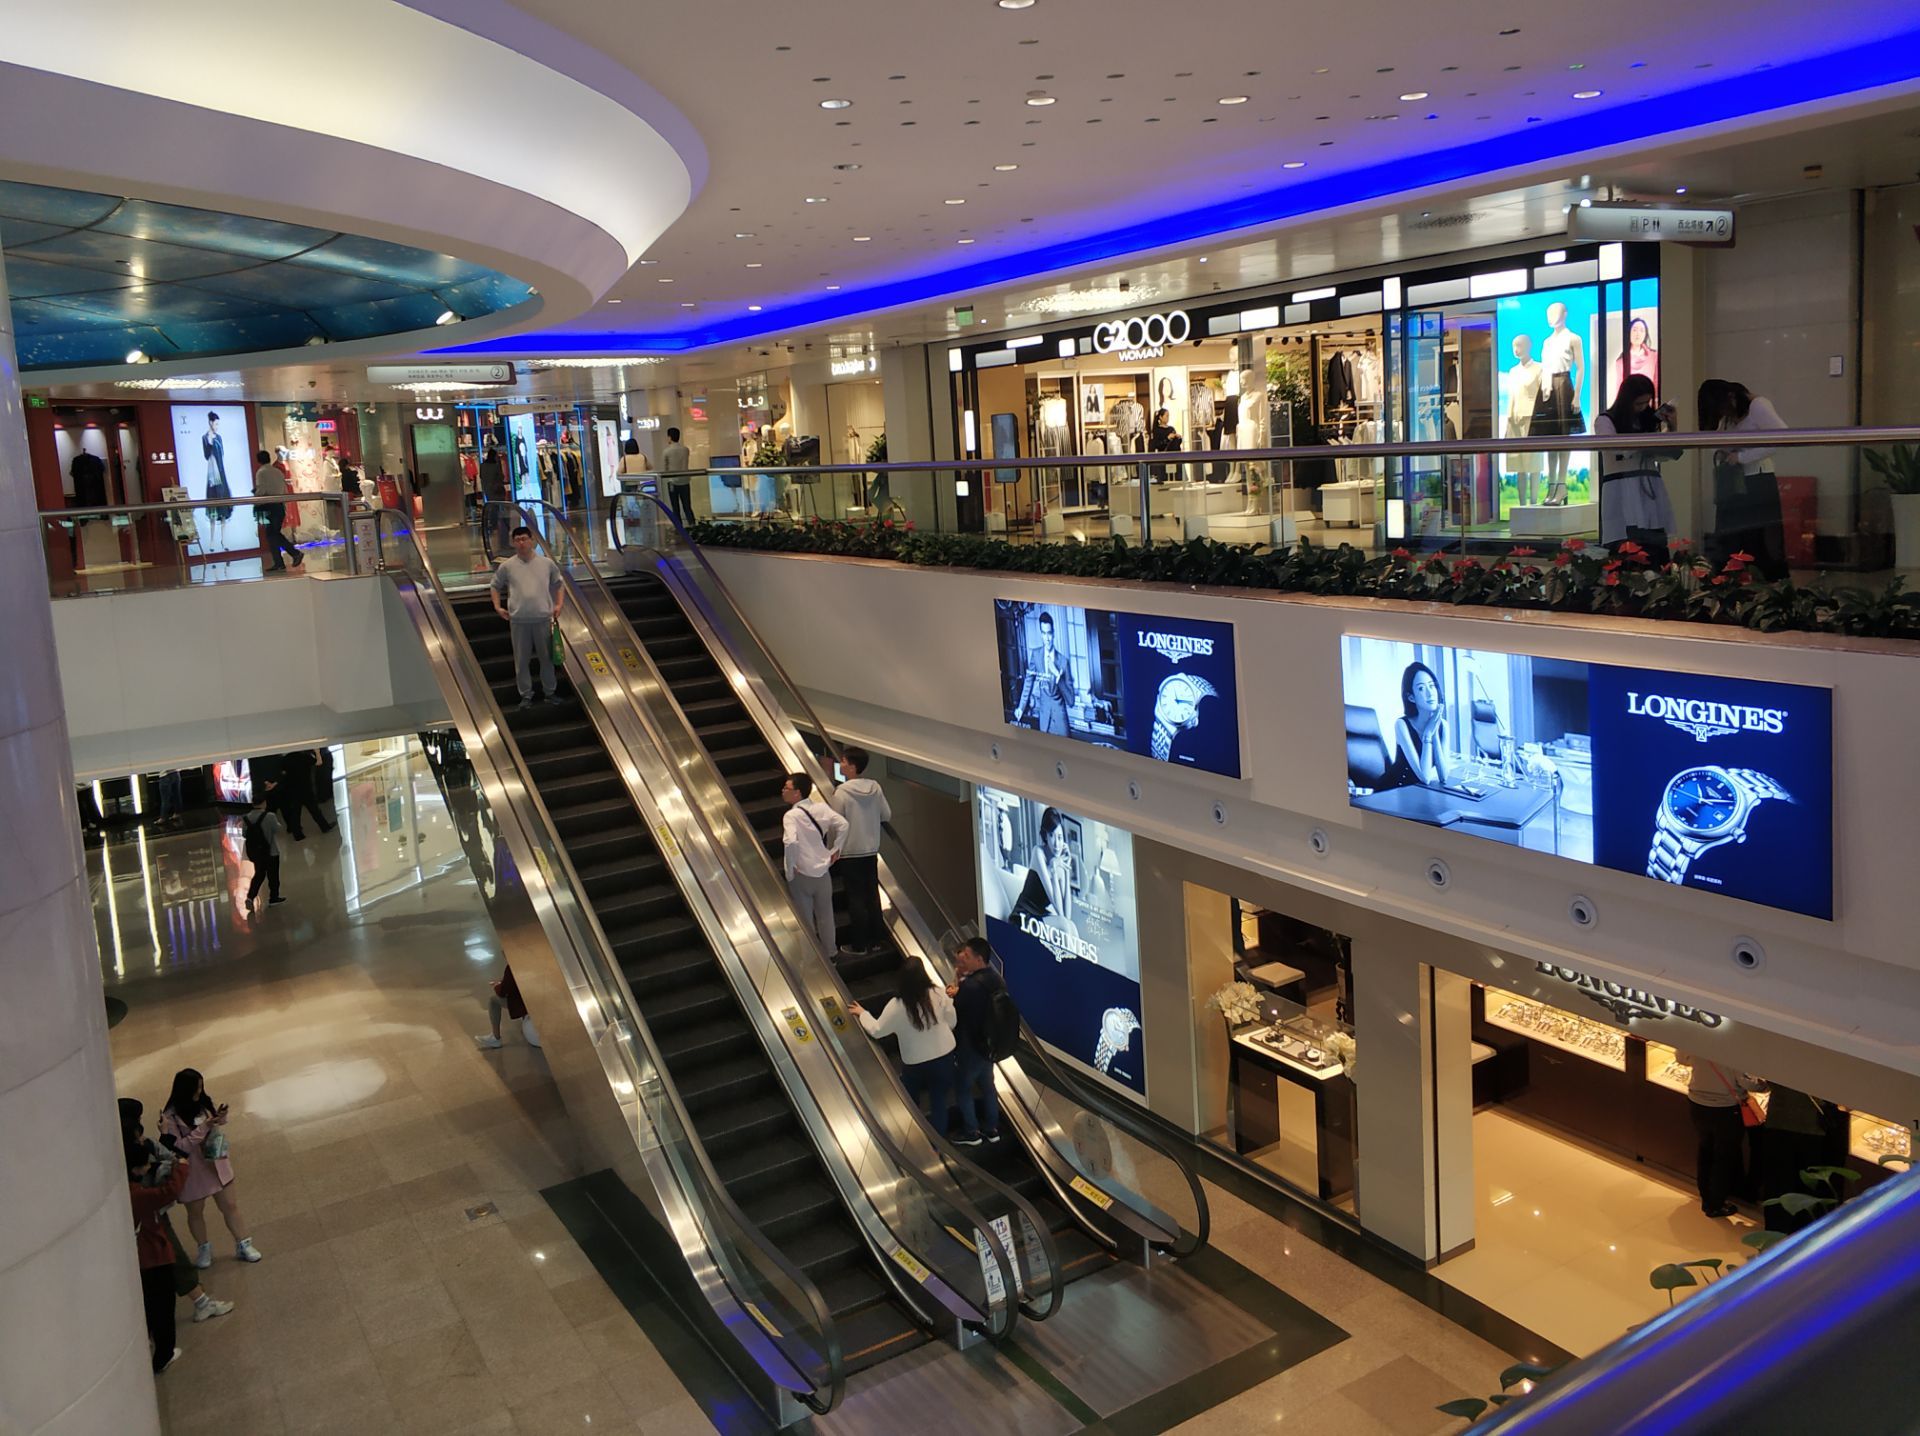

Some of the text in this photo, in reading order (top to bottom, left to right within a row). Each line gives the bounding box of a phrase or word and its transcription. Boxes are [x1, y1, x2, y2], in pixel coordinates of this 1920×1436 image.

[1093, 309, 1190, 354] G2000
[1118, 346, 1164, 362] WOMAN
[1137, 630, 1214, 656] LONGINES
[1627, 692, 1785, 734] LONGINES
[1019, 912, 1098, 965] LONGINES
